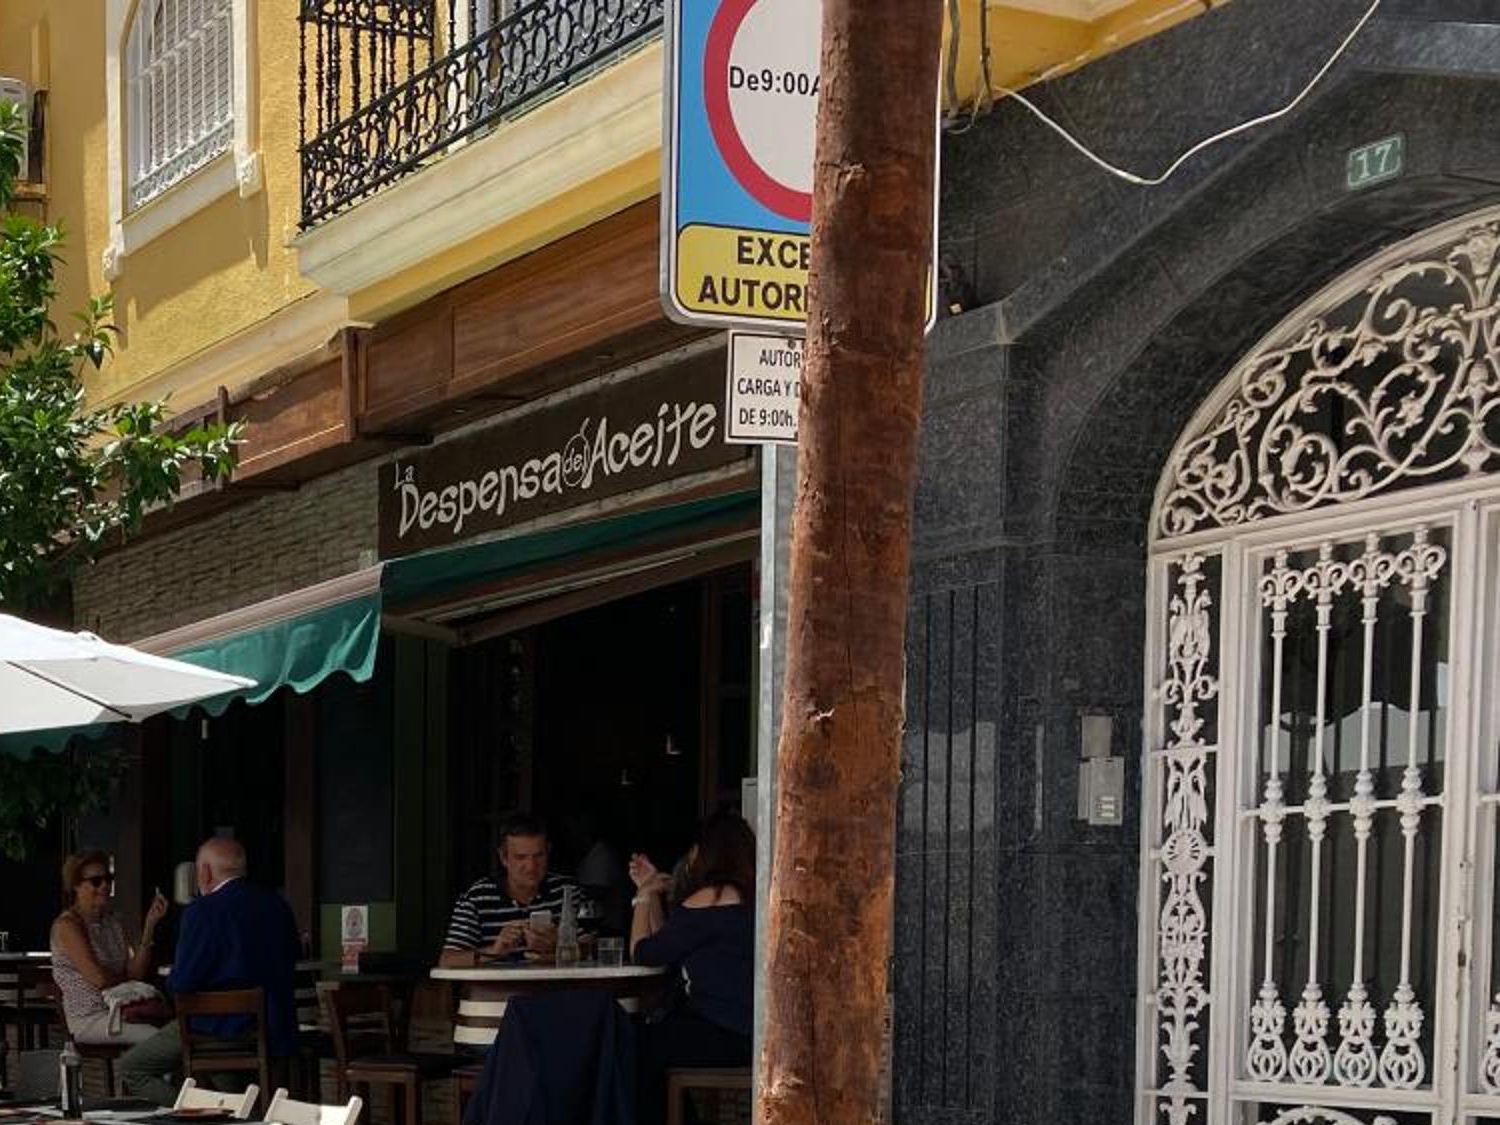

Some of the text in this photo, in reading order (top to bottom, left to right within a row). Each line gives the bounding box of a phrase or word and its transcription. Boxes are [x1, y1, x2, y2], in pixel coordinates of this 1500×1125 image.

[1357, 143, 1393, 178] 17
[737, 377, 781, 397] CARGA
[784, 380, 792, 397] Y
[739, 407, 757, 425] DE
[581, 401, 718, 490] Aceite
[393, 463, 415, 490] La
[399, 452, 563, 538] Despensa
